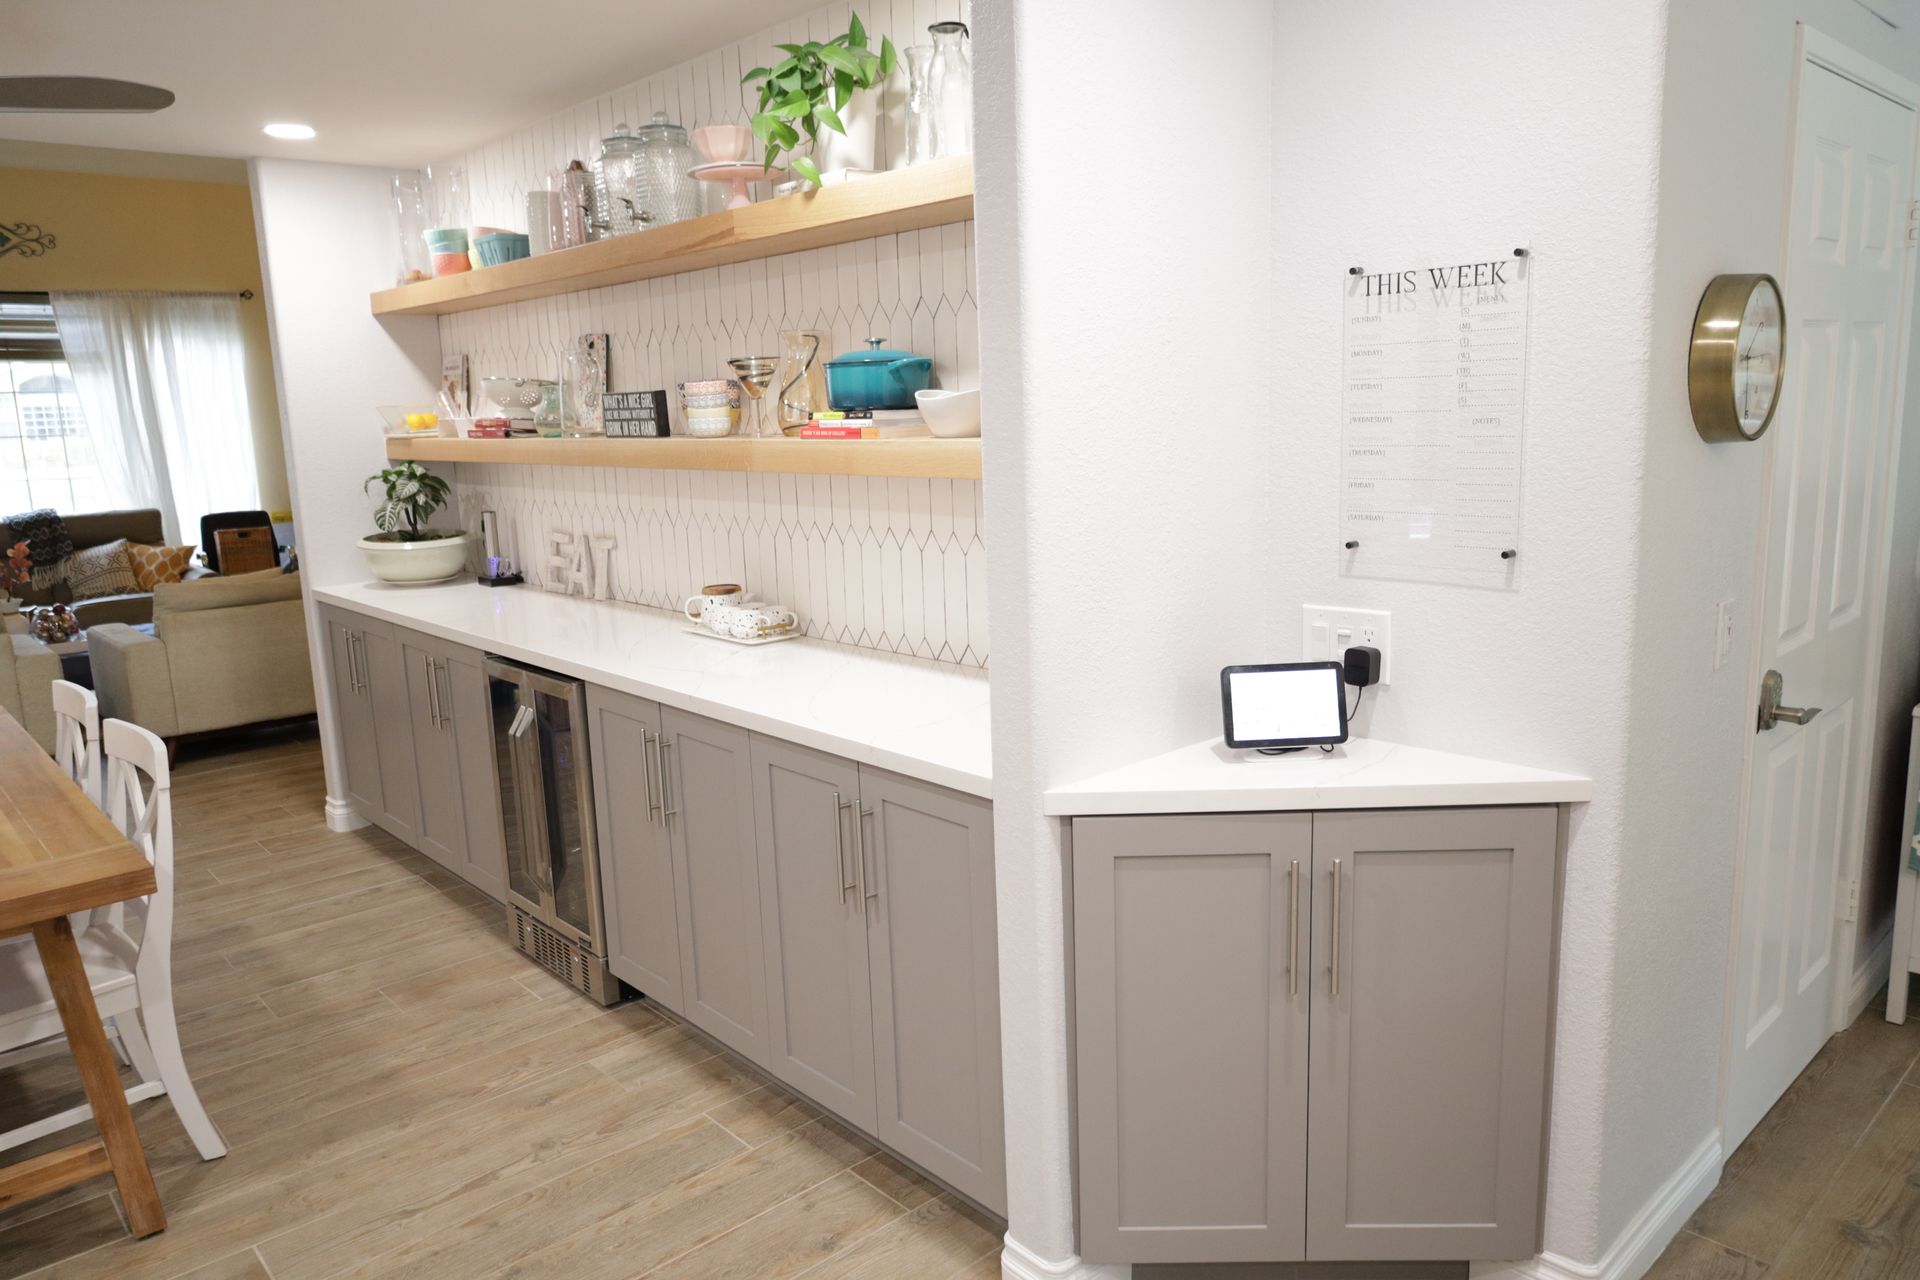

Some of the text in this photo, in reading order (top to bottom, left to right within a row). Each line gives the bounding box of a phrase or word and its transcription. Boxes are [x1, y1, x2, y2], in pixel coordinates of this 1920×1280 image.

[1360, 260, 1508, 296] THIS WEEK
[603, 394, 624, 409] WHAT'S
[624, 394, 628, 408] A
[544, 528, 617, 600] EAT
